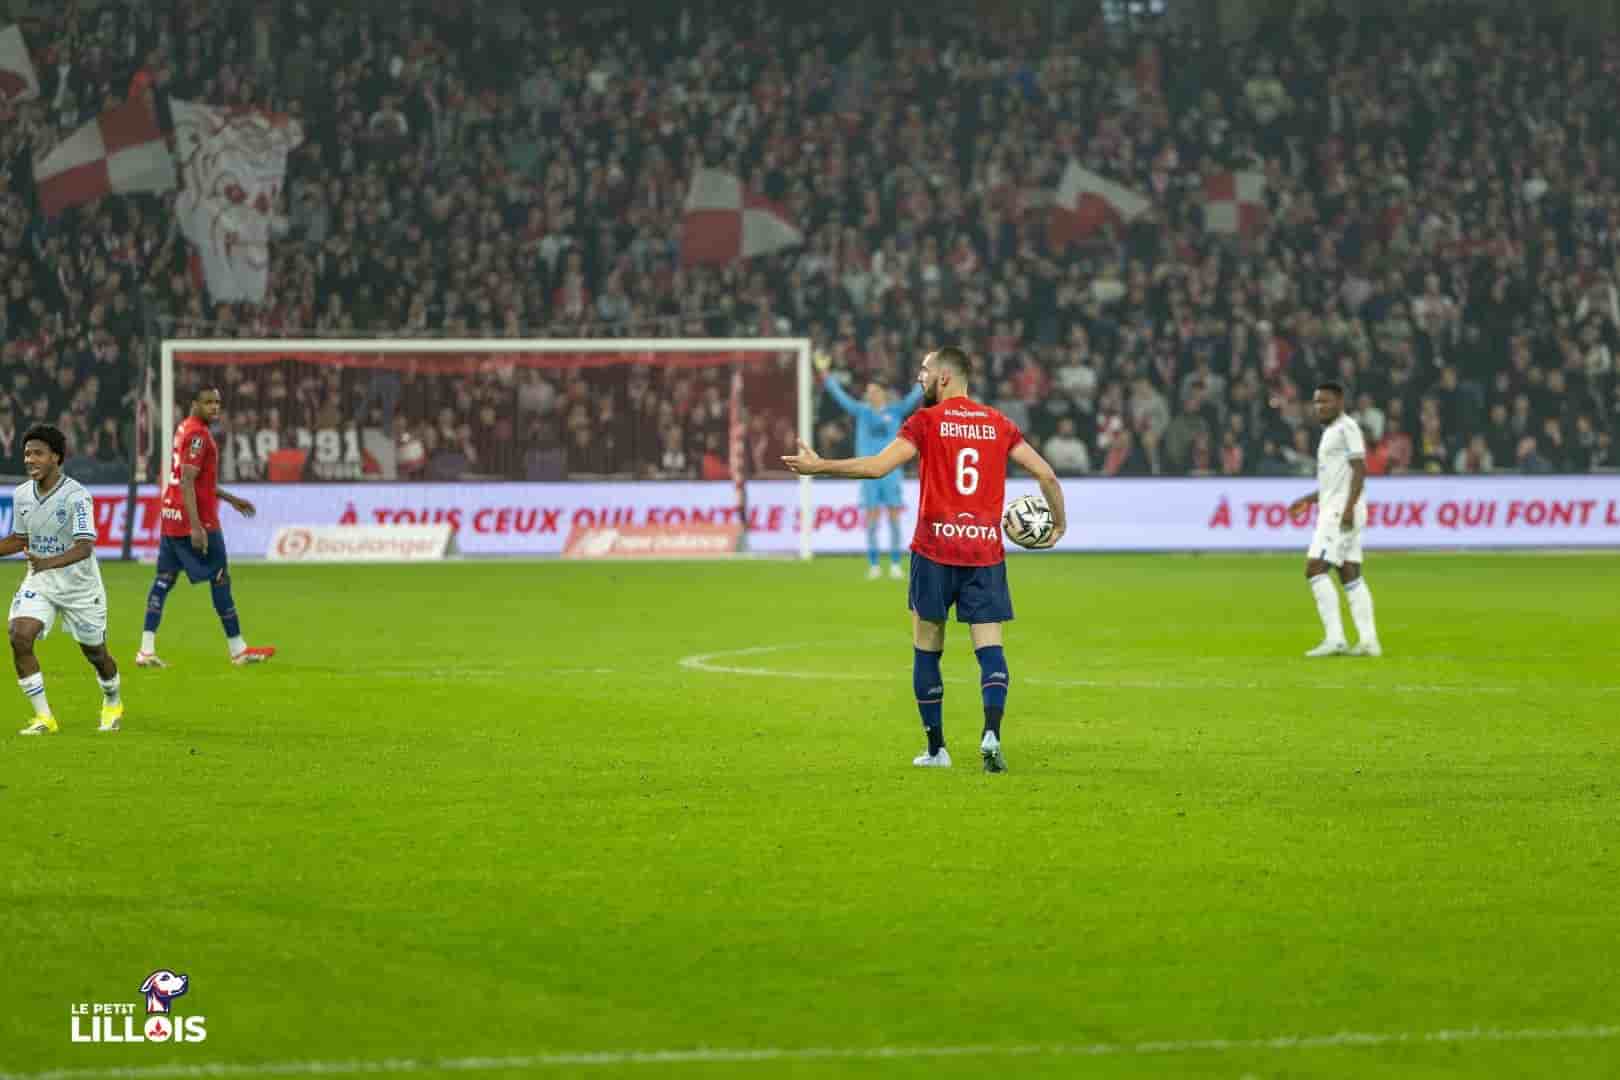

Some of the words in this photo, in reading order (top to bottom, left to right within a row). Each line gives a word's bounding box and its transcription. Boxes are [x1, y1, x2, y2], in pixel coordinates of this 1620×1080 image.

[955, 447, 980, 496] 6
[473, 507, 561, 534] CEUX
[745, 505, 783, 532] LE
[1208, 494, 1232, 529] À
[1247, 502, 1319, 529] TOU
[1365, 501, 1427, 528] EUX
[1437, 500, 1497, 531] QUI
[1506, 500, 1597, 529] FONT
[933, 522, 998, 540] TOYOTA
